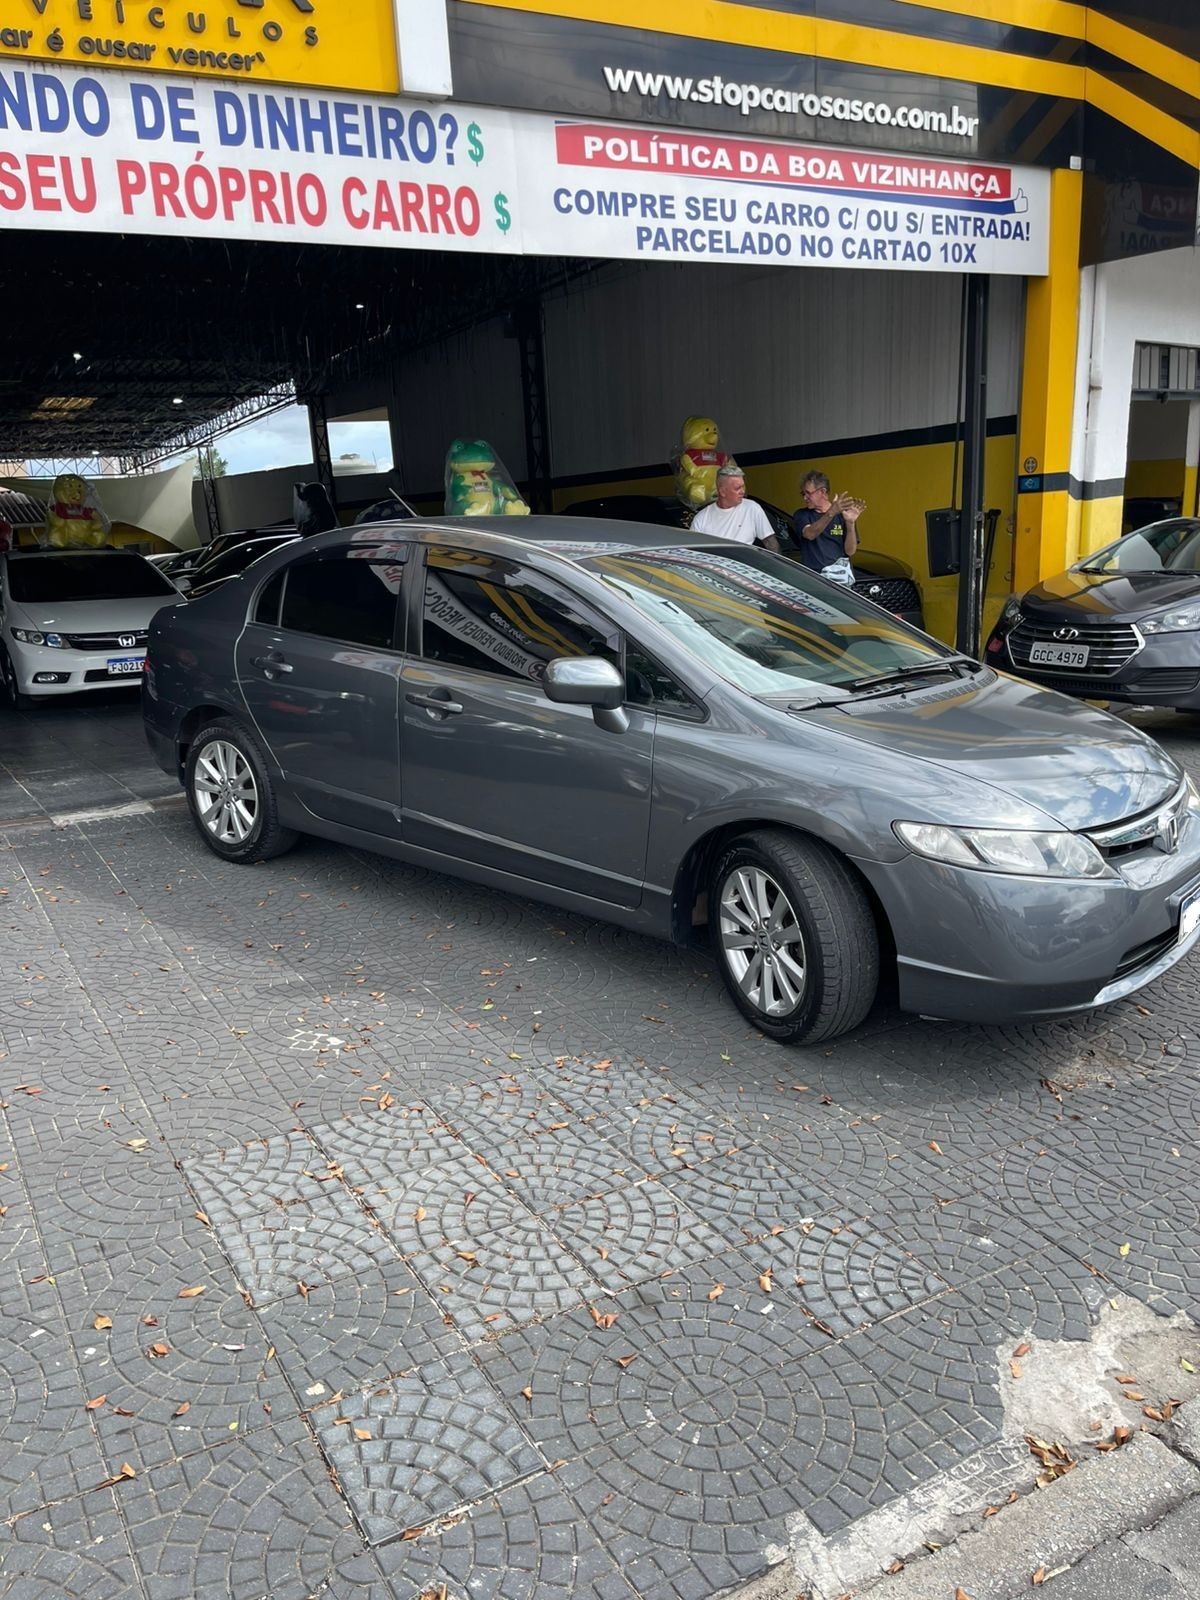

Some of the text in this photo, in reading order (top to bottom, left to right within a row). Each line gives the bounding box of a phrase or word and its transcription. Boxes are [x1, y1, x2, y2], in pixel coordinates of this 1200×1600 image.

[47, 28, 64, 52] é
[78, 36, 156, 61] ousar
[130, 83, 200, 144] DE
[213, 90, 459, 166] DINHEIRO?
[603, 66, 979, 137] www.stopcarosasco.com.br
[0, 152, 97, 213] SEU
[116, 151, 328, 227] PRÓPRIO
[342, 176, 480, 237] CARRO
[584, 135, 1001, 197] POLÍTICA DA BOA VIZINHANÇA
[553, 188, 1030, 241] COMPRE SEU CARRO C/ OU S/ ENTRADA!
[636, 226, 977, 263] PARCELADO NO CARTAO 10X
